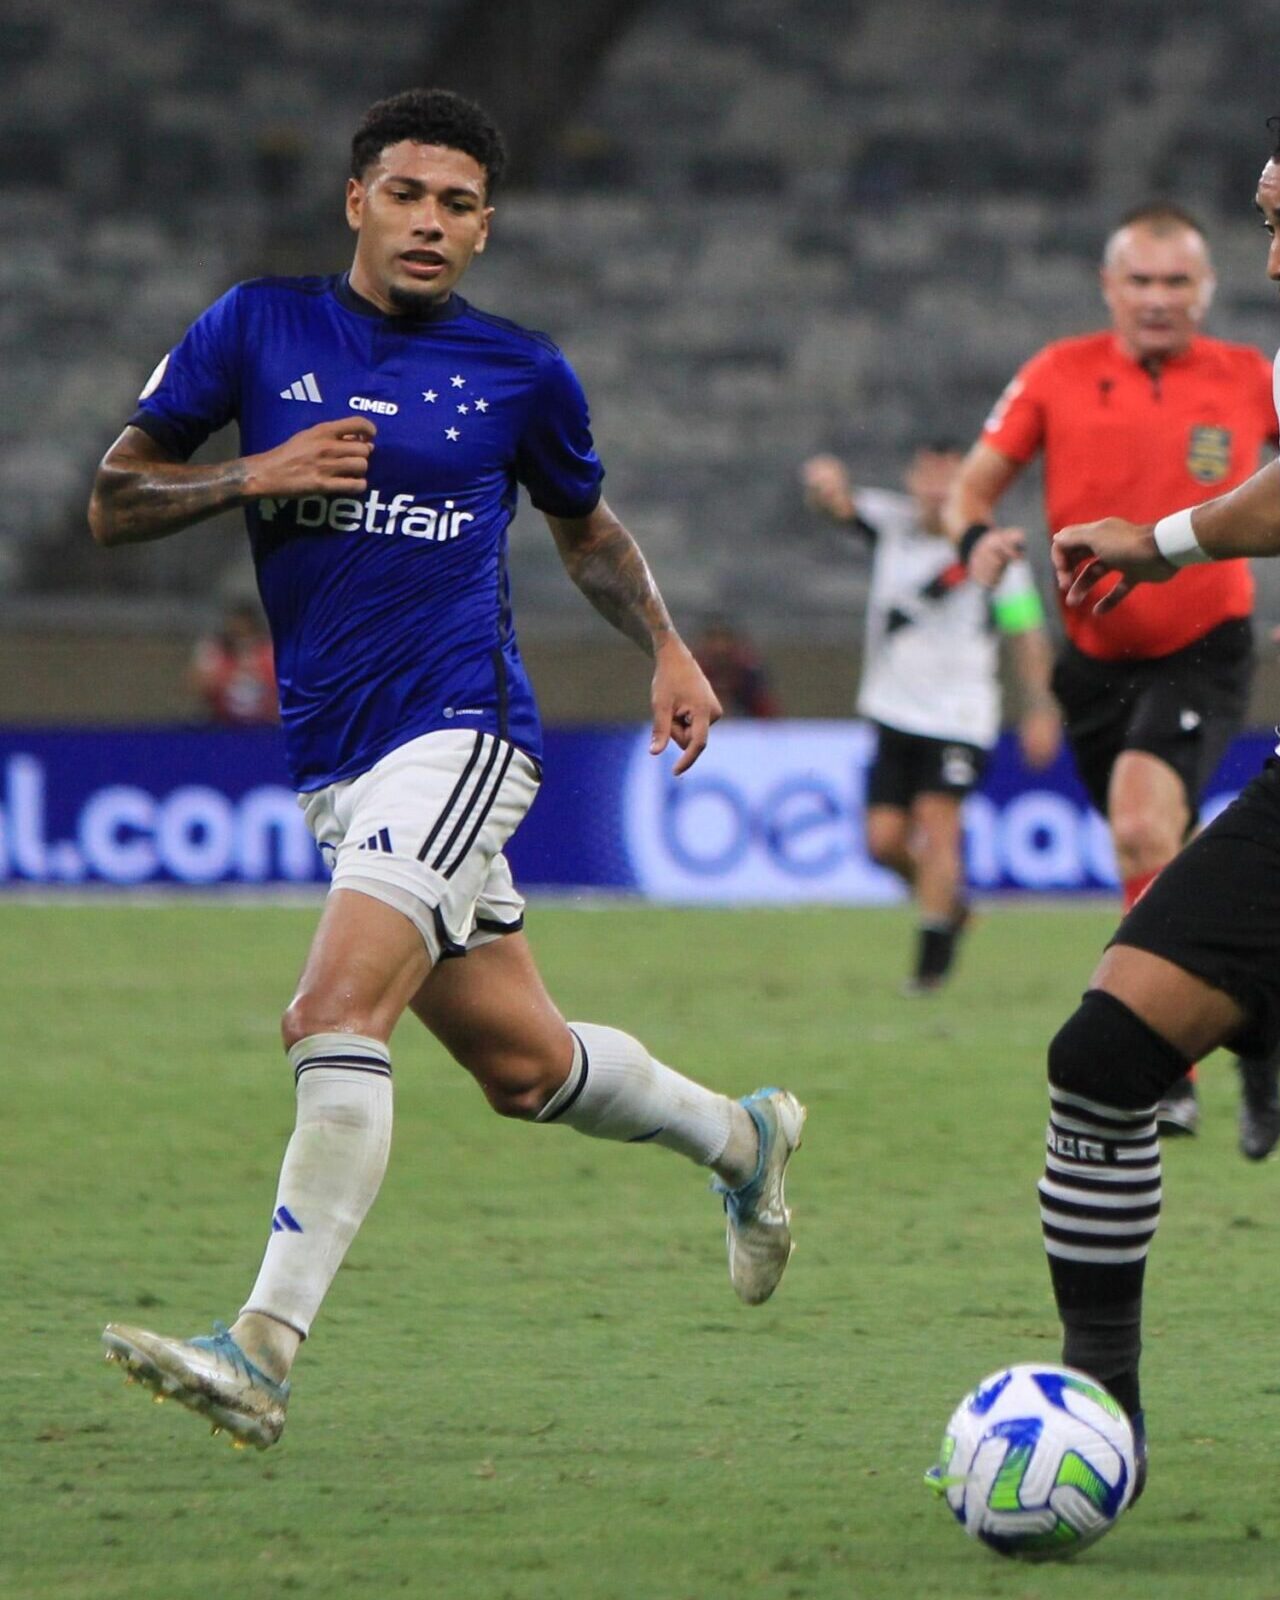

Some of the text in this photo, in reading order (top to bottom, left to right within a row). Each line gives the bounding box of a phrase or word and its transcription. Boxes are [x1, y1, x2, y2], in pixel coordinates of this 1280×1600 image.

[348, 396, 398, 416] CIMED
[296, 489, 475, 541] betfair
[3, 753, 318, 884] l.com
